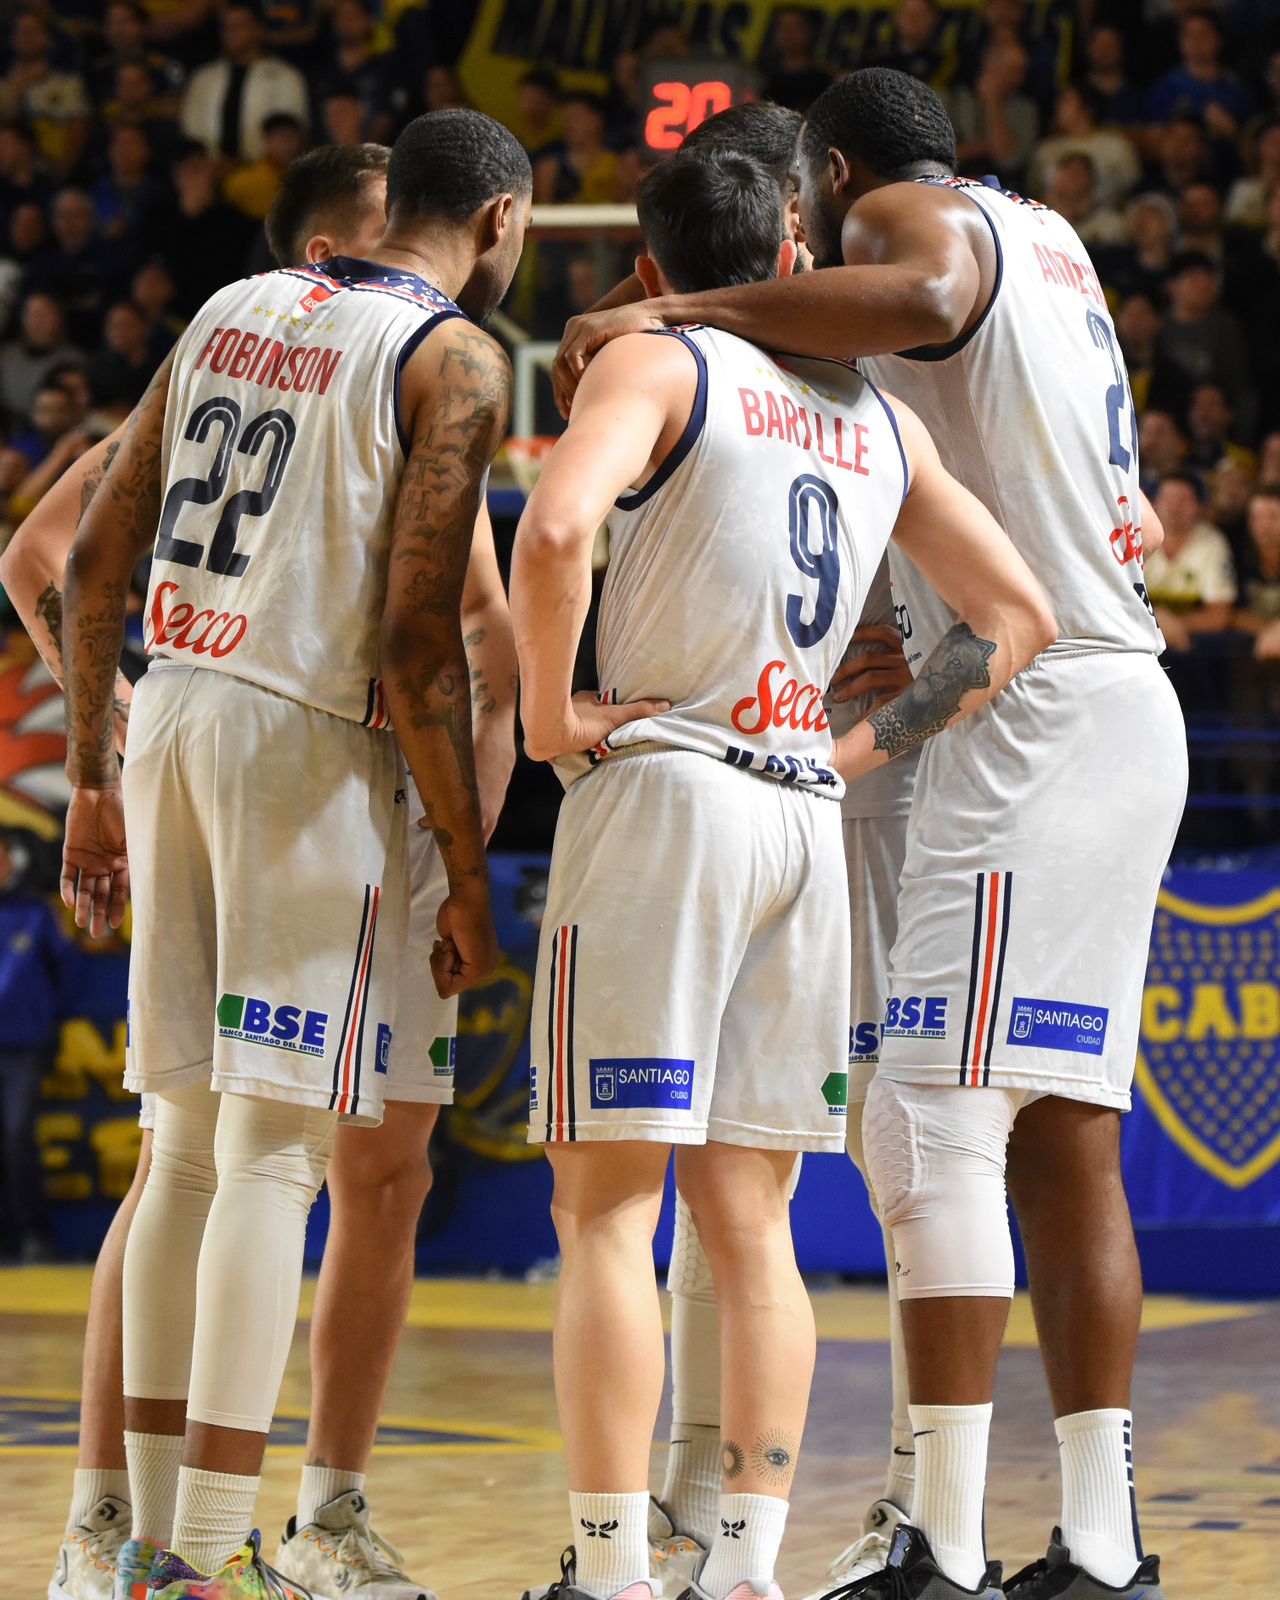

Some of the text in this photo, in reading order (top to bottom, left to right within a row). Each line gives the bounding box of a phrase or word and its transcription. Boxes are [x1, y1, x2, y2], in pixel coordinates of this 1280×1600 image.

[645, 82, 732, 149] 20
[1086, 308, 1138, 475] 2
[154, 396, 297, 578] 22
[785, 473, 841, 649] 9
[144, 581, 247, 659] Secco
[242, 997, 329, 1047] BSE
[884, 996, 948, 1030] BSE
[1035, 1009, 1104, 1032] SANTIAGO
[218, 1027, 325, 1055] BANCO SANTIAGO DEL ESTERO
[920, 1029, 946, 1037] ESTERO
[1076, 1034, 1101, 1046] CIUDAD
[618, 1068, 690, 1086] SANTIAGO
[670, 1090, 689, 1100] CIUDAD
